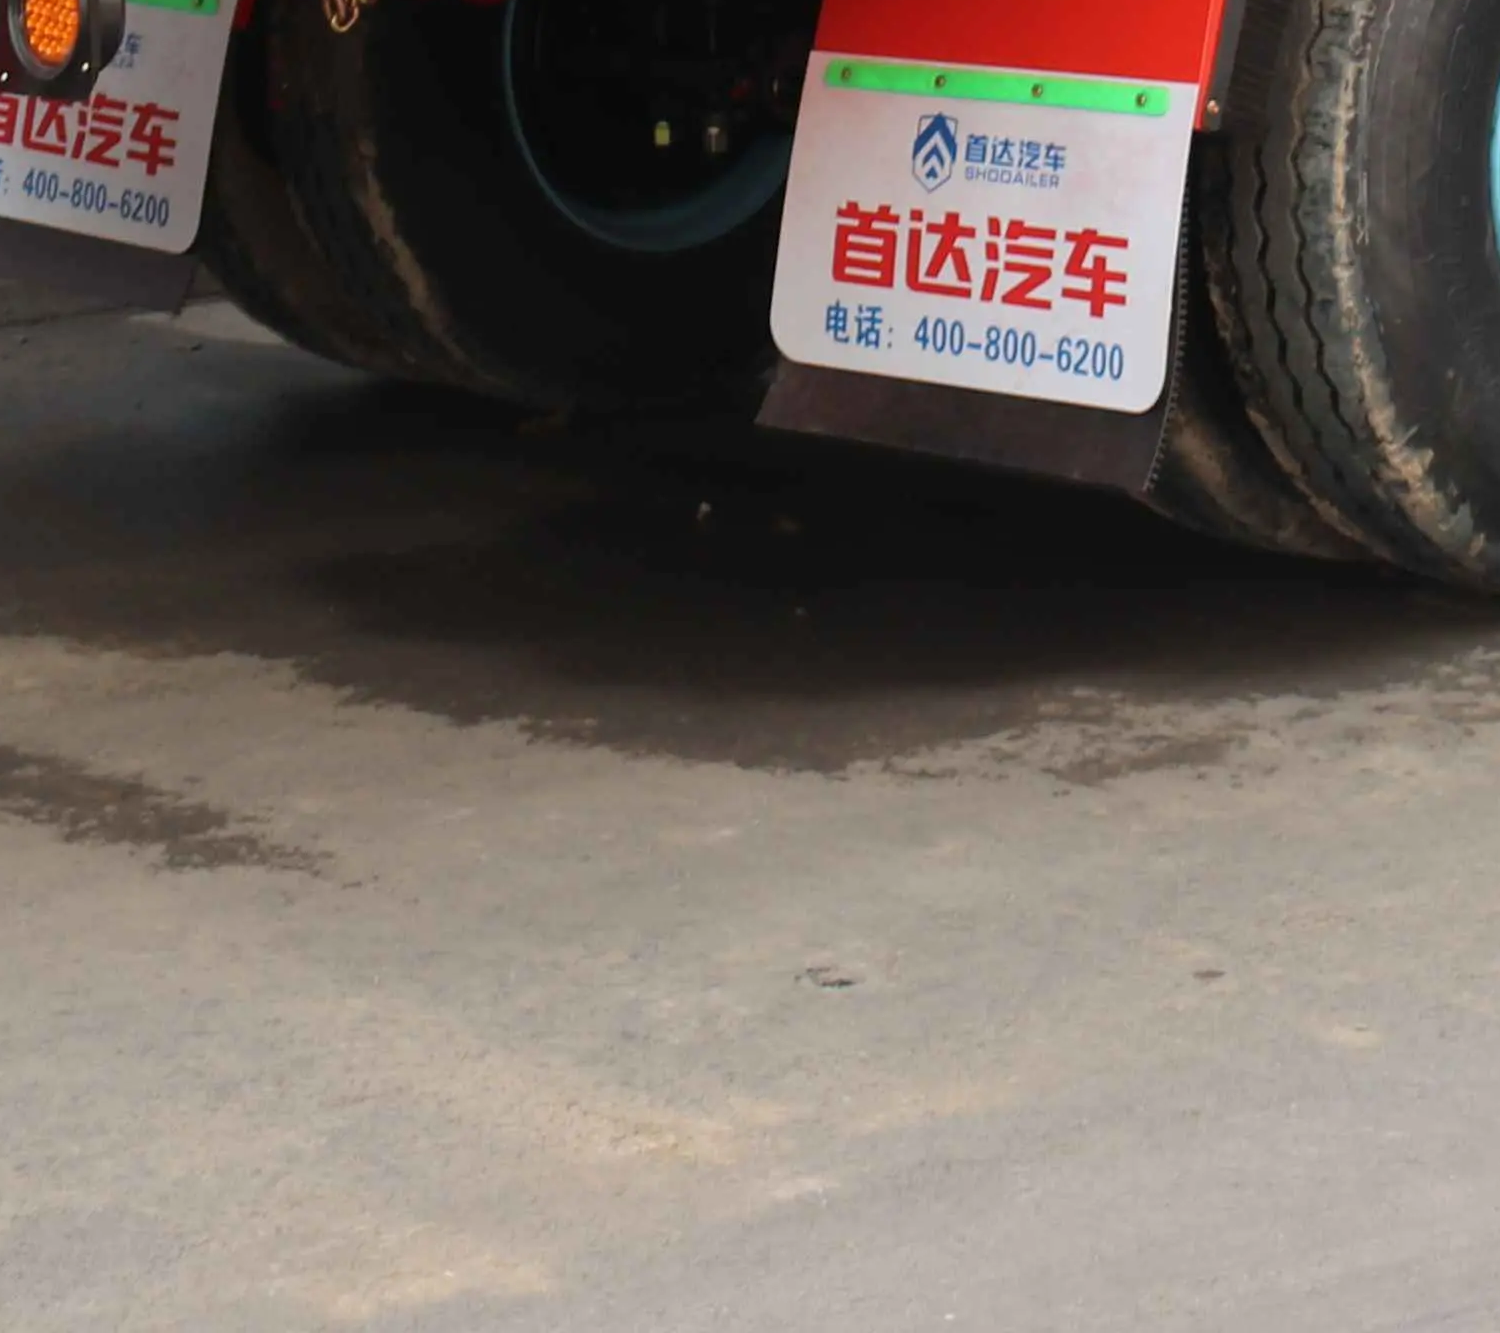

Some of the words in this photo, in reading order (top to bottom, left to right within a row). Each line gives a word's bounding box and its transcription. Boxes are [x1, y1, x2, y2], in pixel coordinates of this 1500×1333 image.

[964, 134, 1067, 173] 首达汽车
[22, 168, 171, 228] 400-800-6200
[831, 200, 1129, 319] 首达汽车
[913, 316, 1125, 381] 400-800-6200
